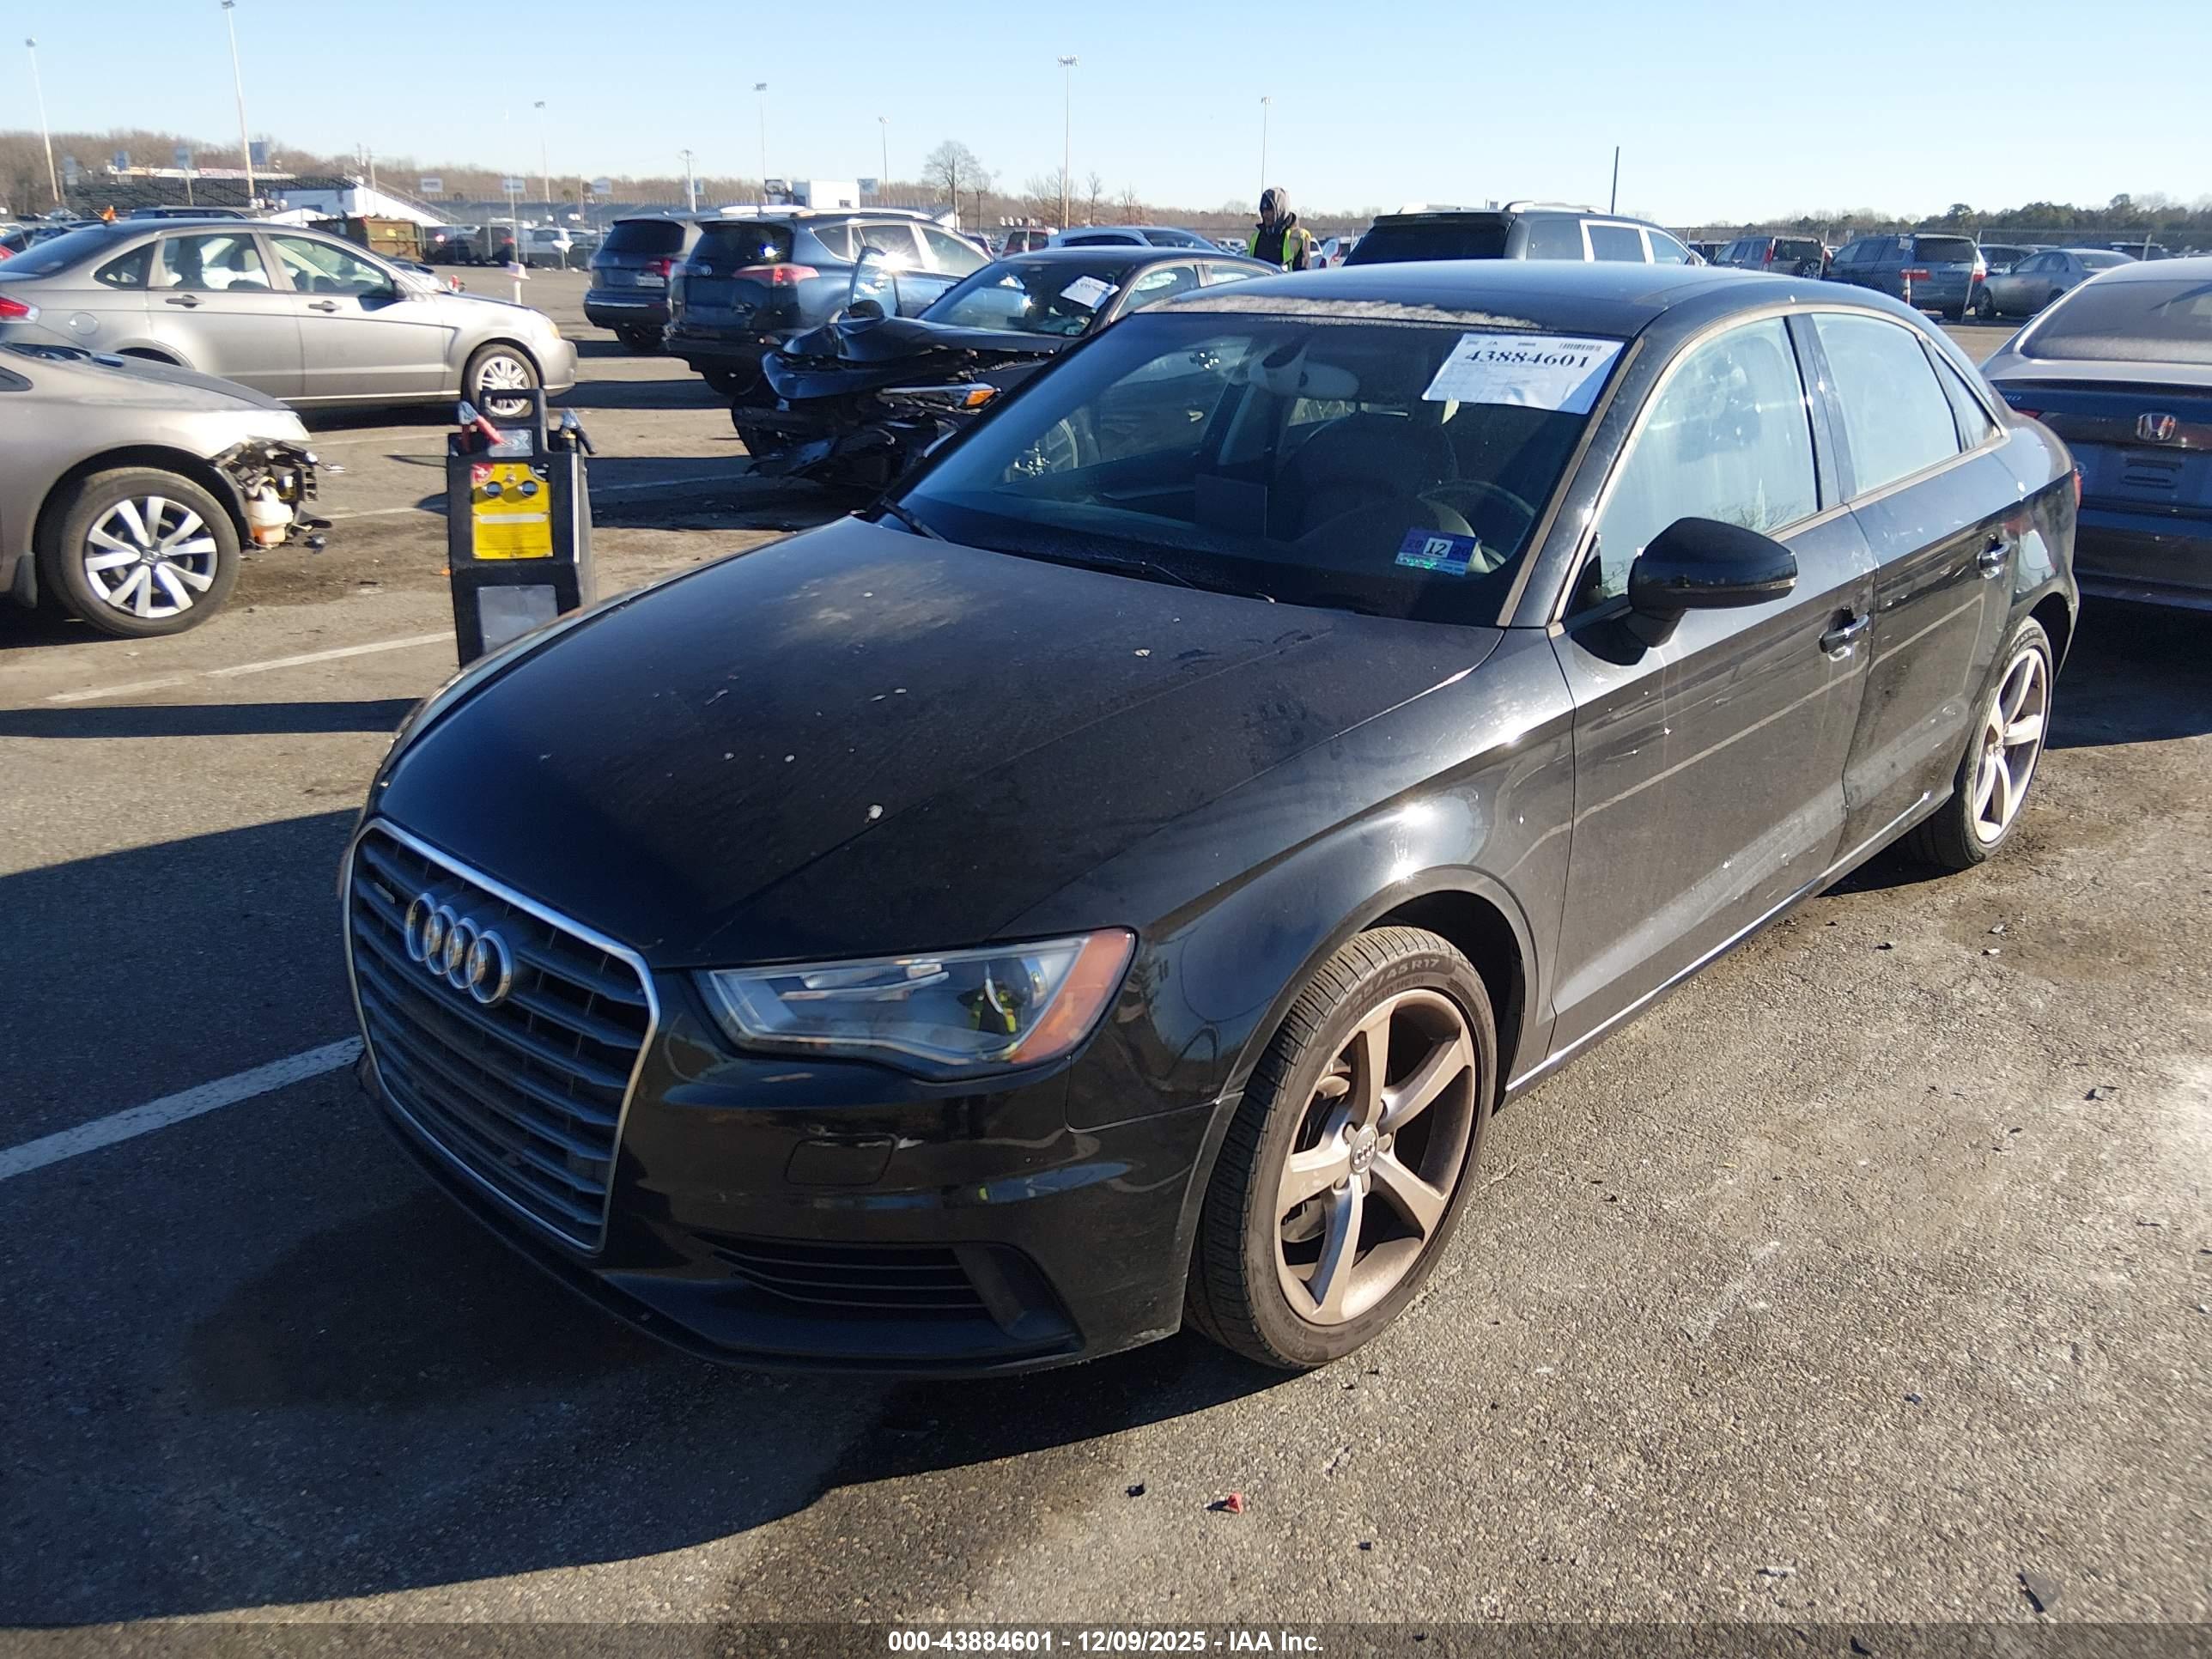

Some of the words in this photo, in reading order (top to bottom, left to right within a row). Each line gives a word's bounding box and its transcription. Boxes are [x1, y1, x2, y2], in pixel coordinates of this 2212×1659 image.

[1464, 349, 1589, 368] 43884601
[1425, 542, 1448, 556] 12
[1411, 957, 1441, 970] R17
